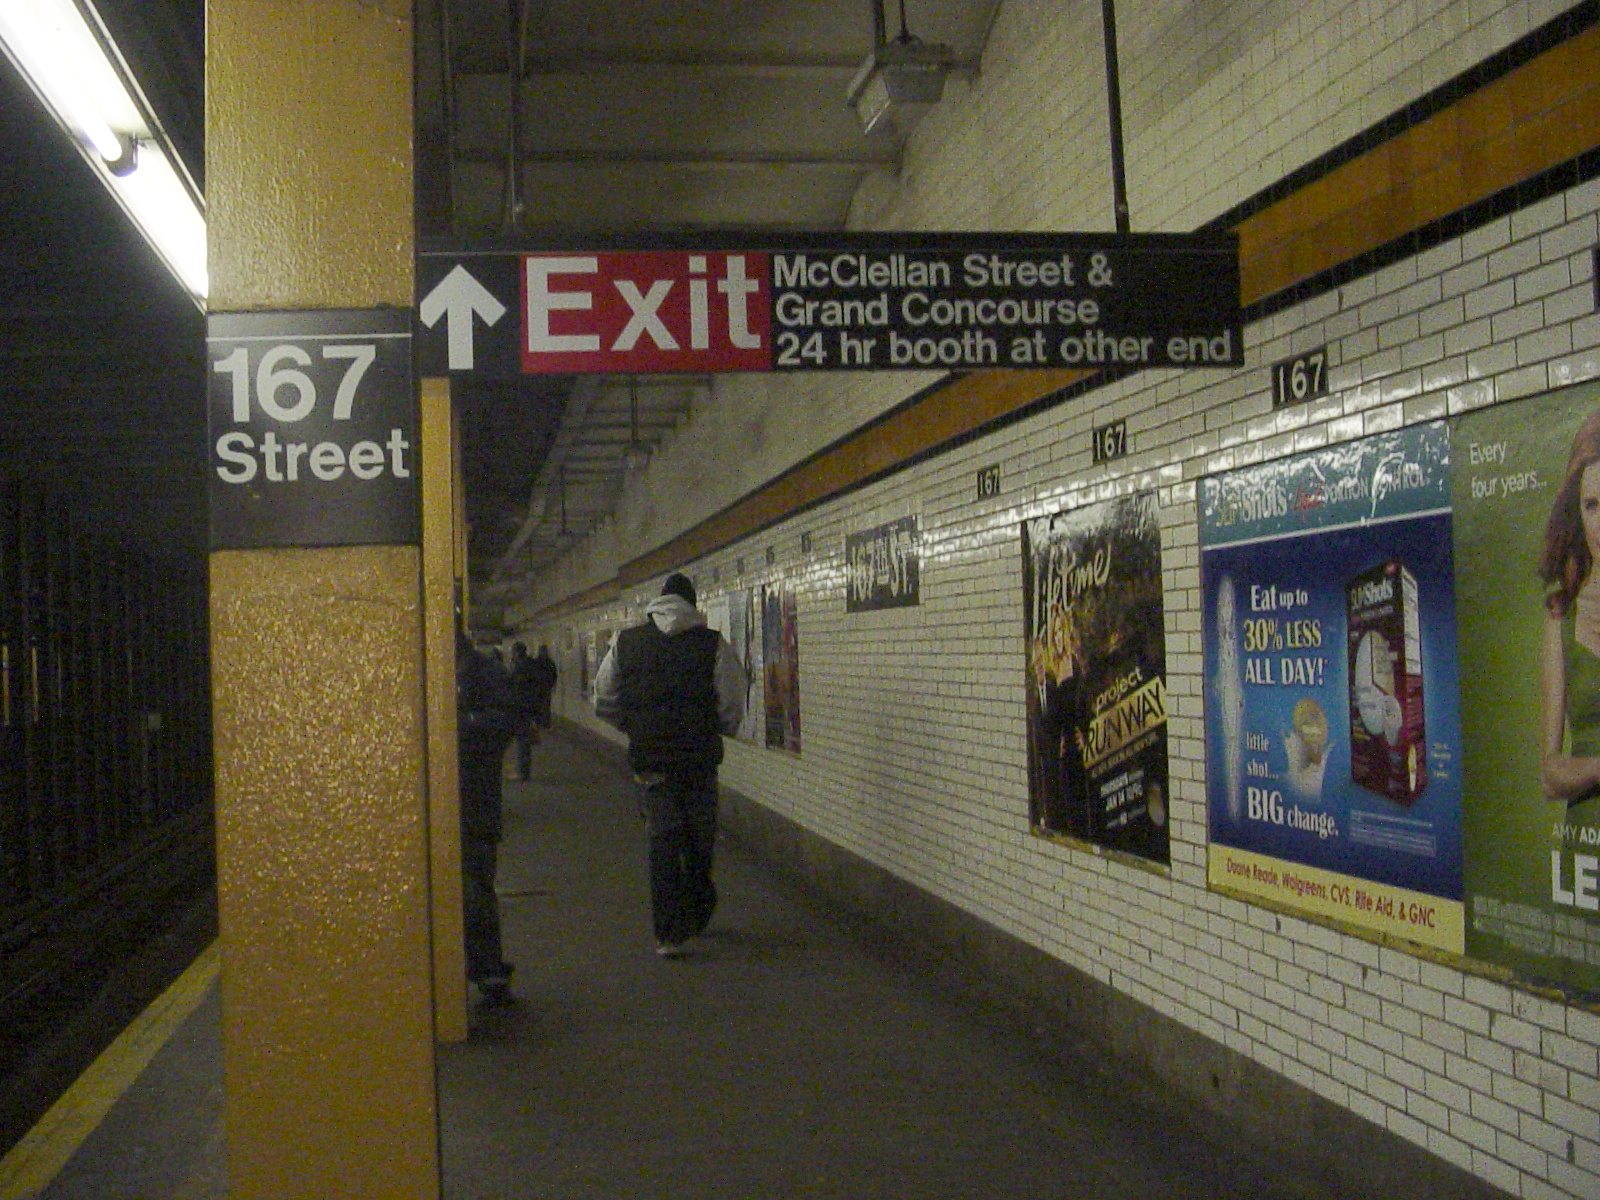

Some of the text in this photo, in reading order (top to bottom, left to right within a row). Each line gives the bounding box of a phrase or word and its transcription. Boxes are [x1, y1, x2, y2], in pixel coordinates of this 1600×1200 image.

[773, 254, 1113, 289] McClellan Street &
[526, 254, 762, 354] Exit
[775, 292, 1100, 328] Grand Concourse
[776, 329, 1232, 366] 24 hr booth at other end
[213, 343, 377, 424] 167
[1278, 353, 1325, 404] 167
[215, 428, 411, 485] Street
[1095, 424, 1126, 461] 167
[1469, 440, 1508, 465] Every
[979, 468, 1000, 496] 167
[1471, 475, 1498, 498] four
[1250, 585, 1309, 612] Eat up to
[1243, 618, 1322, 652] 30% LESS
[1245, 656, 1325, 686] ALL DAY!
[1096, 665, 1144, 718] project
[1084, 681, 1166, 763] RUNWAY
[1246, 731, 1270, 753] little
[1247, 786, 1284, 825] BIG
[1287, 805, 1339, 840] change.
[1552, 822, 1578, 841] AMY
[1398, 901, 1406, 921] &
[1408, 903, 1436, 928] GNC
